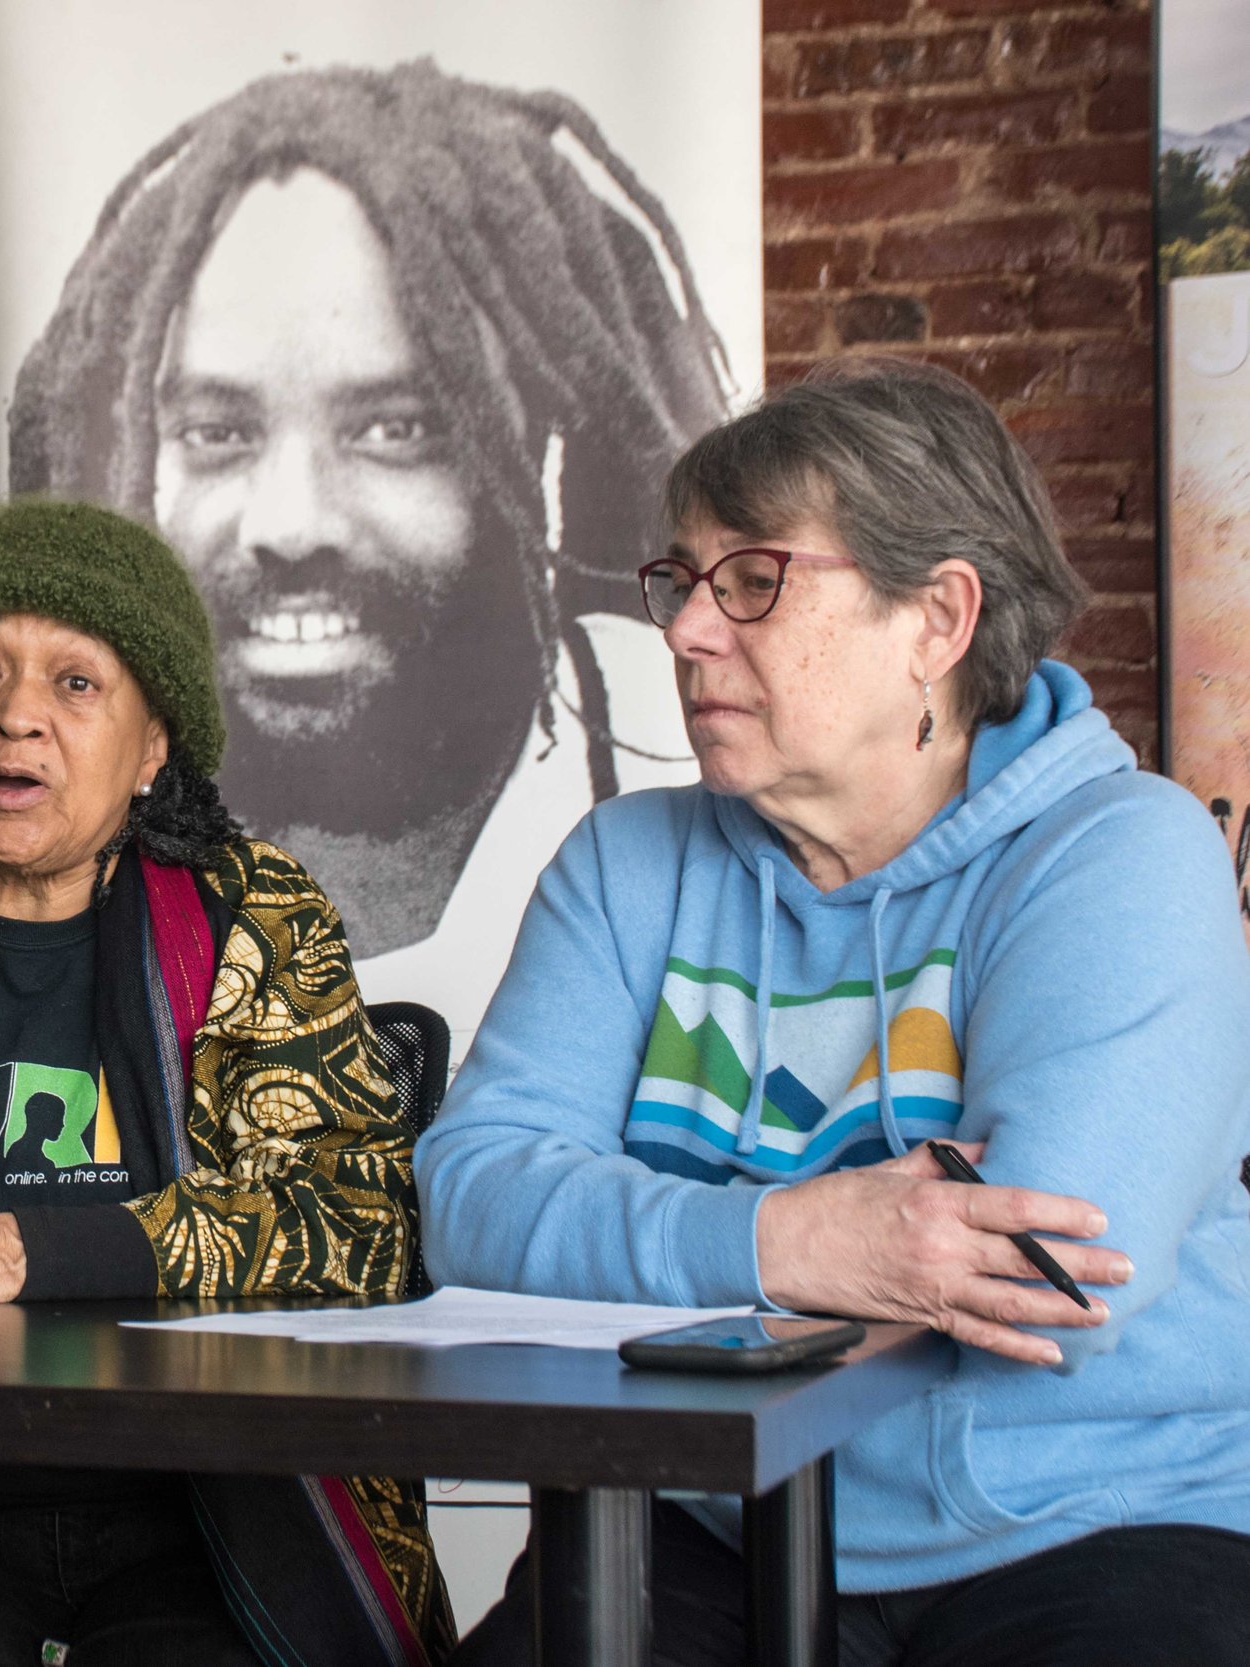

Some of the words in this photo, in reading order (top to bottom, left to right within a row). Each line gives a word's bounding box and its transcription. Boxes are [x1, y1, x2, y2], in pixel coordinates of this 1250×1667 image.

[5, 1171, 48, 1186] online.
[58, 1171, 71, 1184] in
[74, 1169, 96, 1183] the
